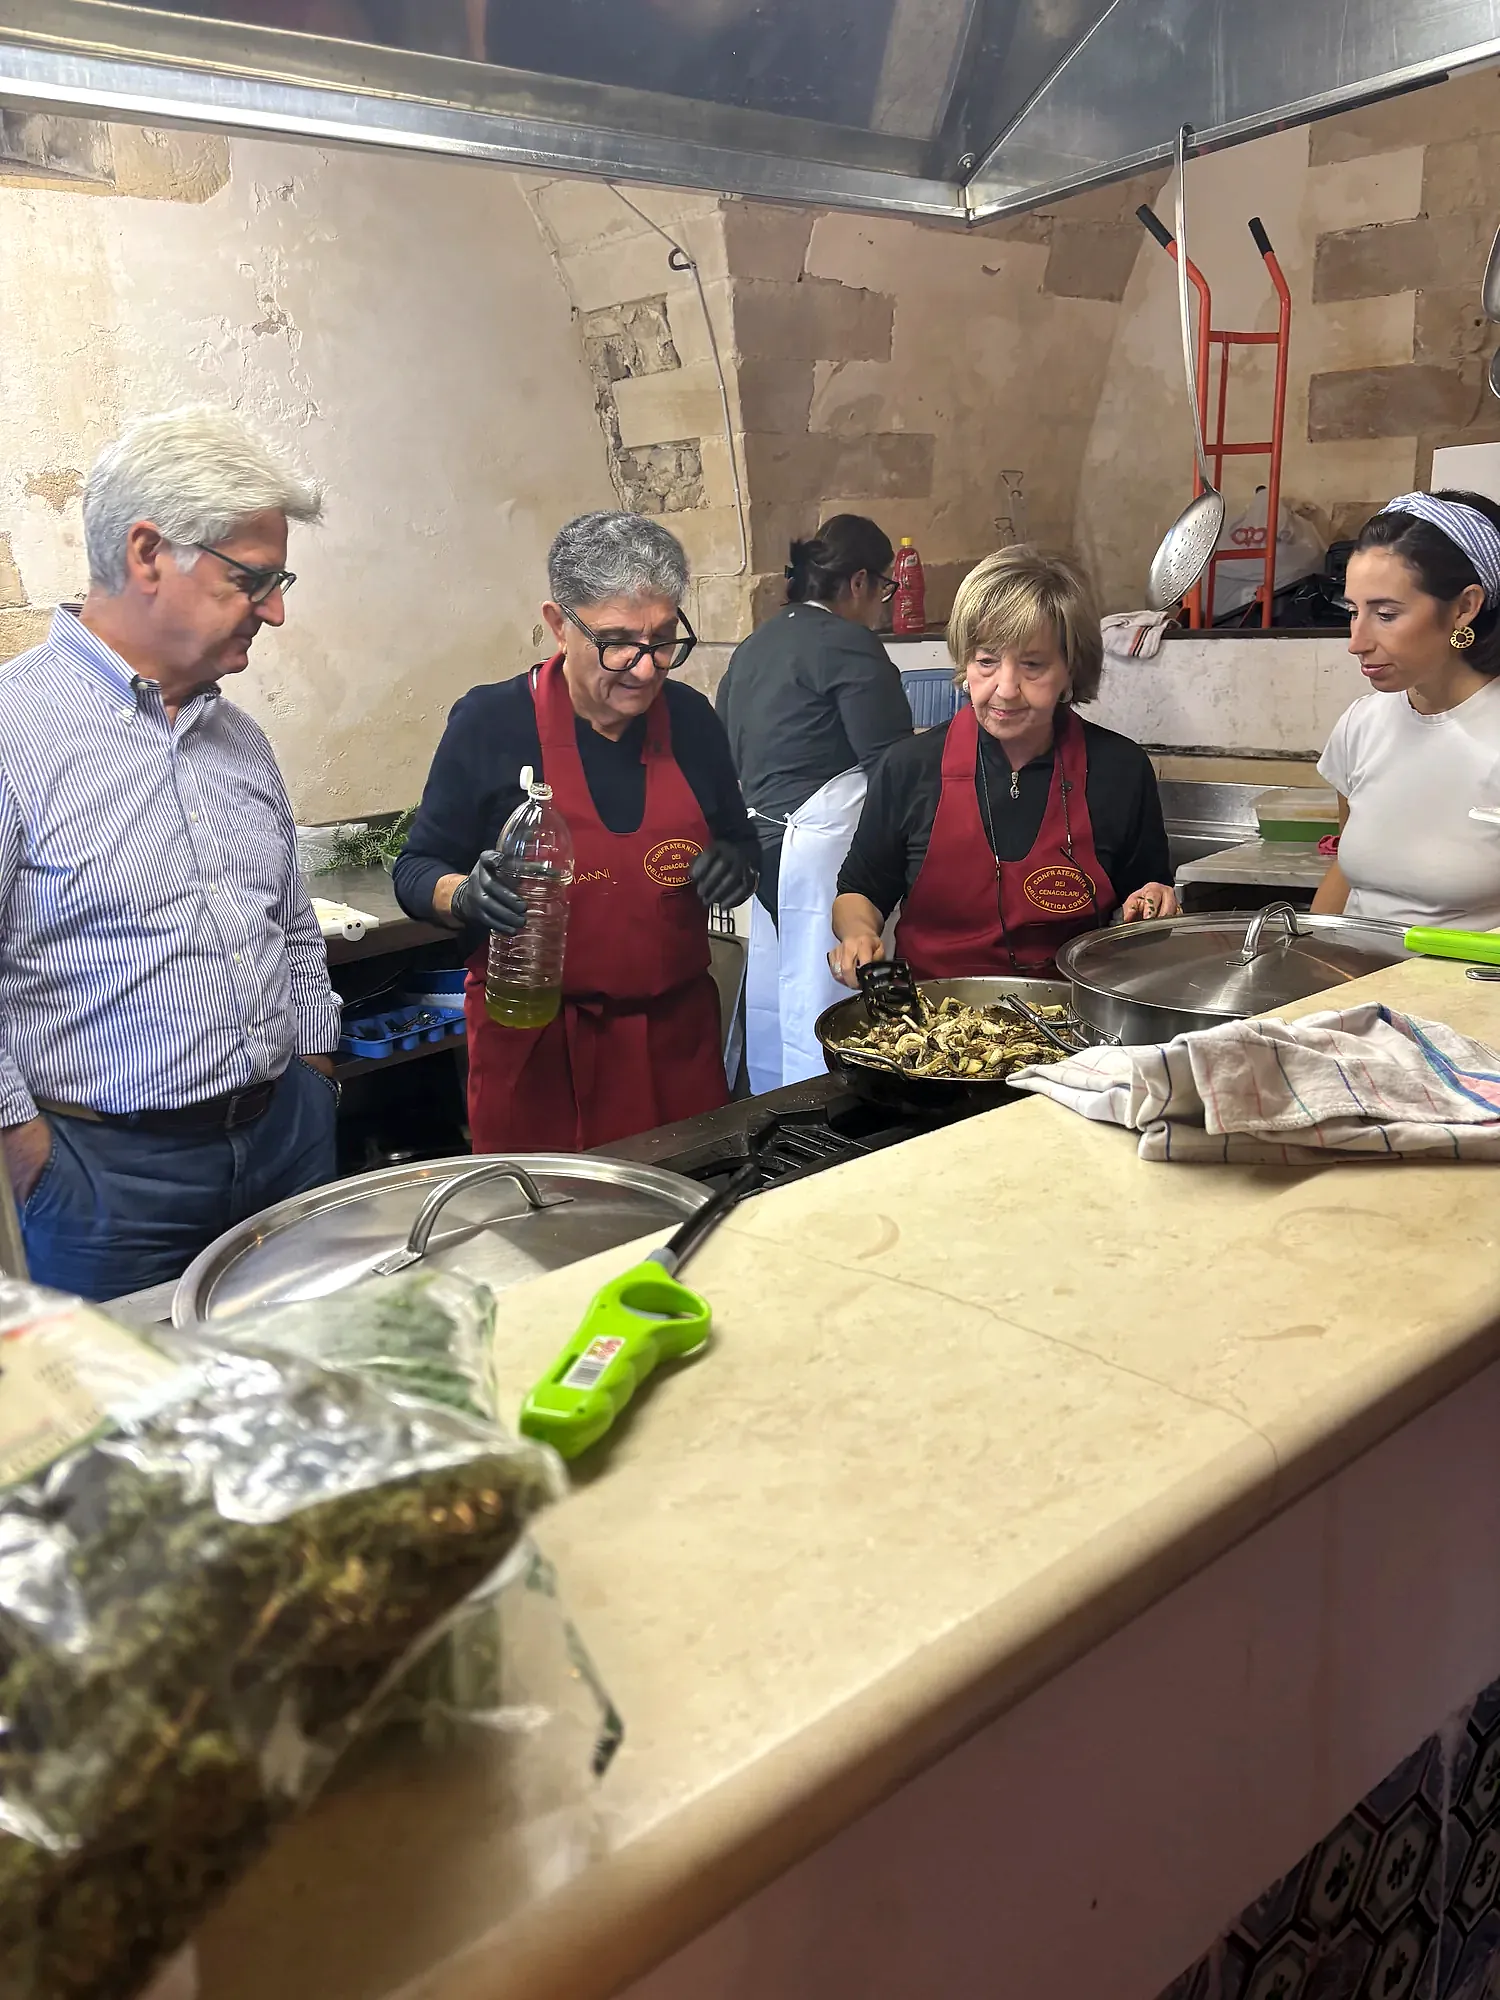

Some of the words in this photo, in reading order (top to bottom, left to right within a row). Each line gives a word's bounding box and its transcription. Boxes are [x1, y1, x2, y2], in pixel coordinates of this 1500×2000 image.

[671, 853, 681, 861] DEI
[660, 862, 690, 871] CENACOLA
[573, 868, 610, 884] IANNI
[1039, 889, 1079, 897] CENACOLARI
[1068, 890, 1091, 910] CONTE
